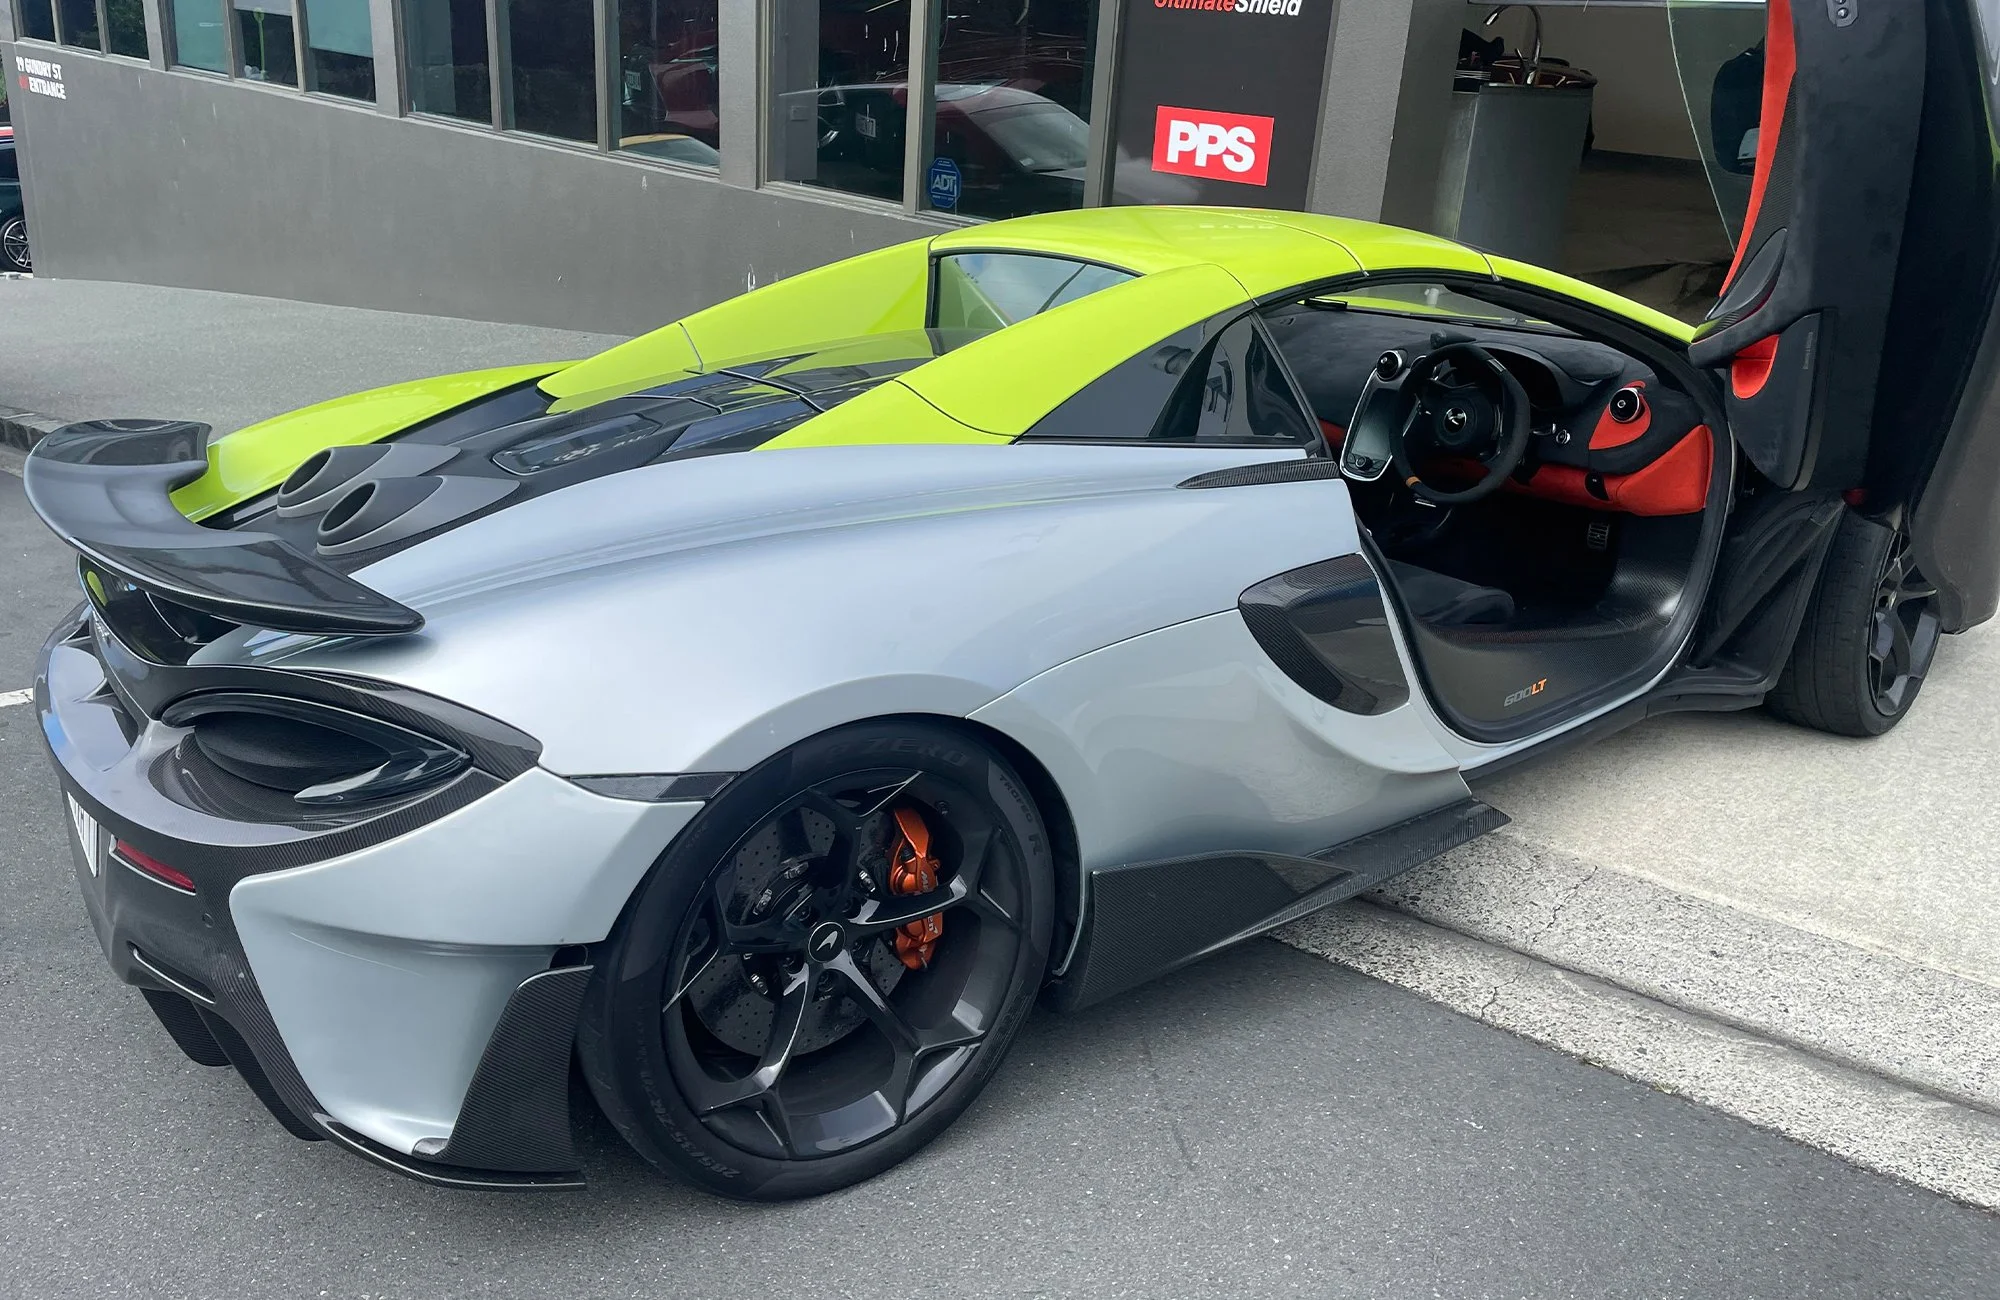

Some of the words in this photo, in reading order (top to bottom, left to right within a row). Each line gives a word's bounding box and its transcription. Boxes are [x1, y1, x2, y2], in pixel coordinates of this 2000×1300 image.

[24, 57, 52, 78] GUNDRY
[52, 63, 62, 80] ST
[28, 76, 67, 100] ENTRANCE
[1167, 119, 1256, 173] PPS
[932, 174, 957, 192] ADT
[1503, 678, 1547, 707] 600LT
[1028, 833, 1044, 856] R
